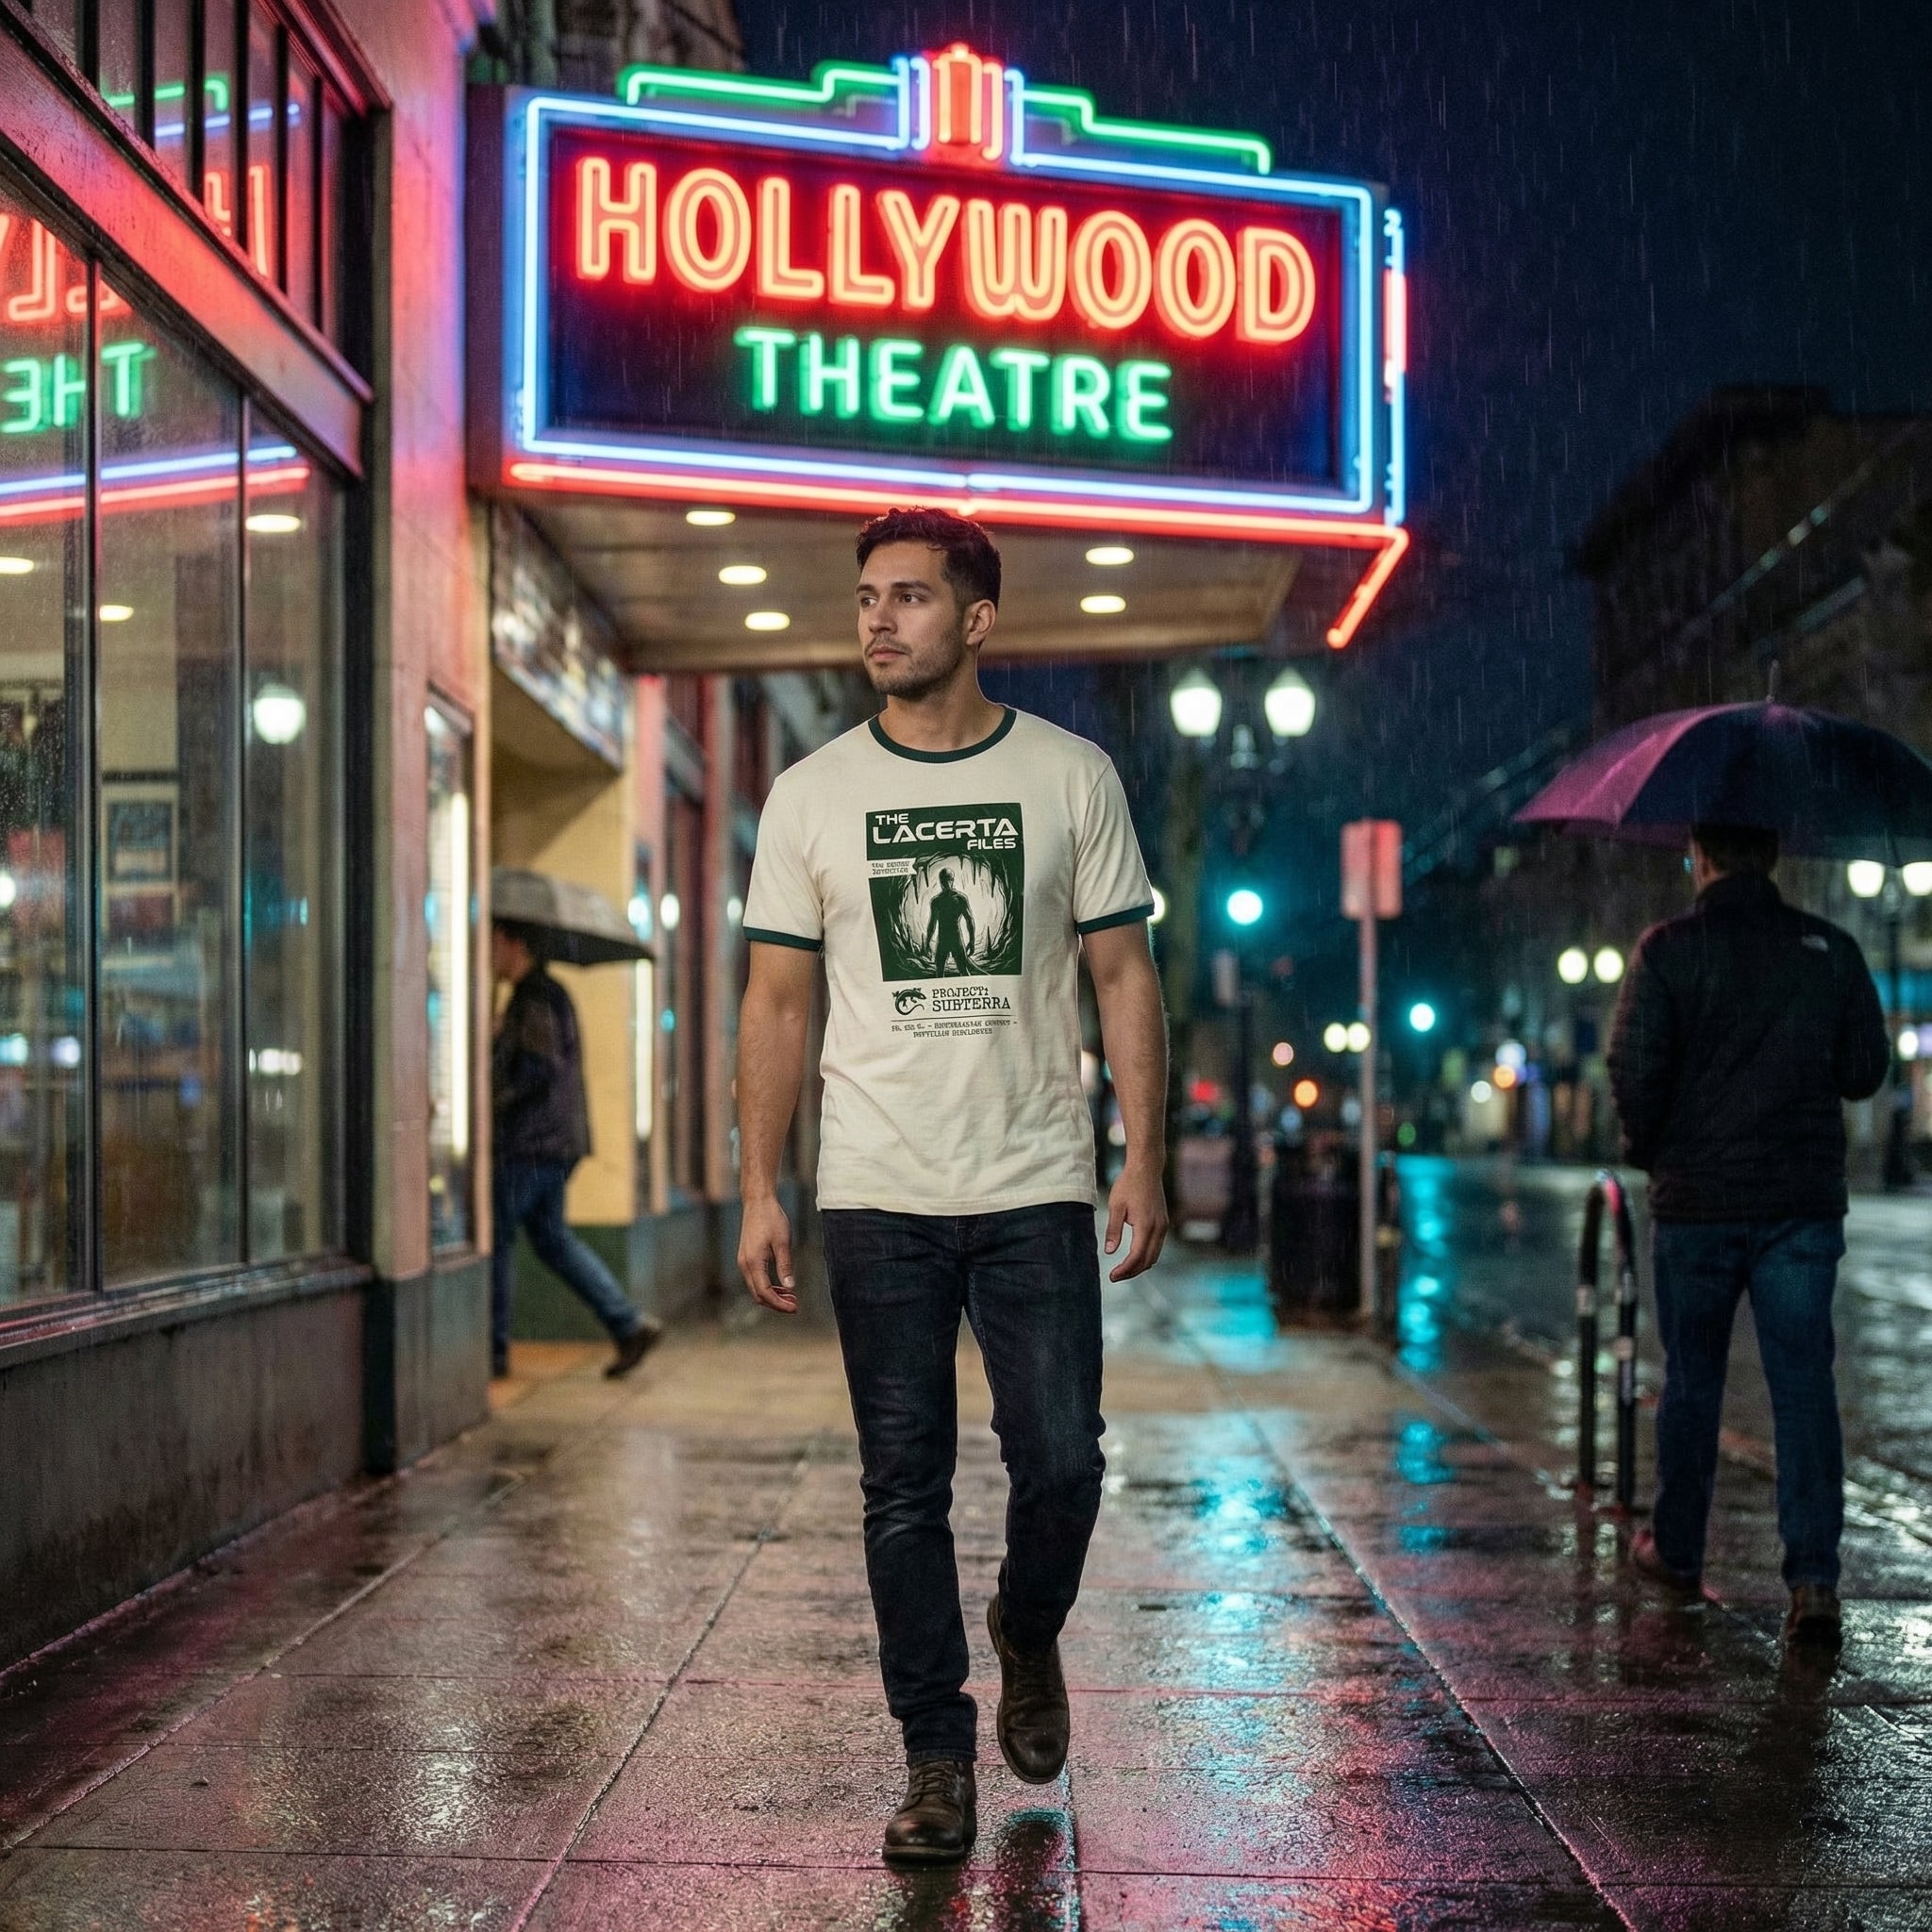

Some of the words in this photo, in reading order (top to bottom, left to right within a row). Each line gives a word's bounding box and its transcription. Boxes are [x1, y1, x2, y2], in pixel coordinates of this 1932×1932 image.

[575, 156, 1317, 344] HOLLYWOOD
[734, 325, 1173, 442] THEATRE
[874, 813, 909, 825] THE
[873, 818, 1019, 844] LACERTA
[967, 838, 1017, 851] FILES
[932, 997, 1011, 1012] SUBTERRA
